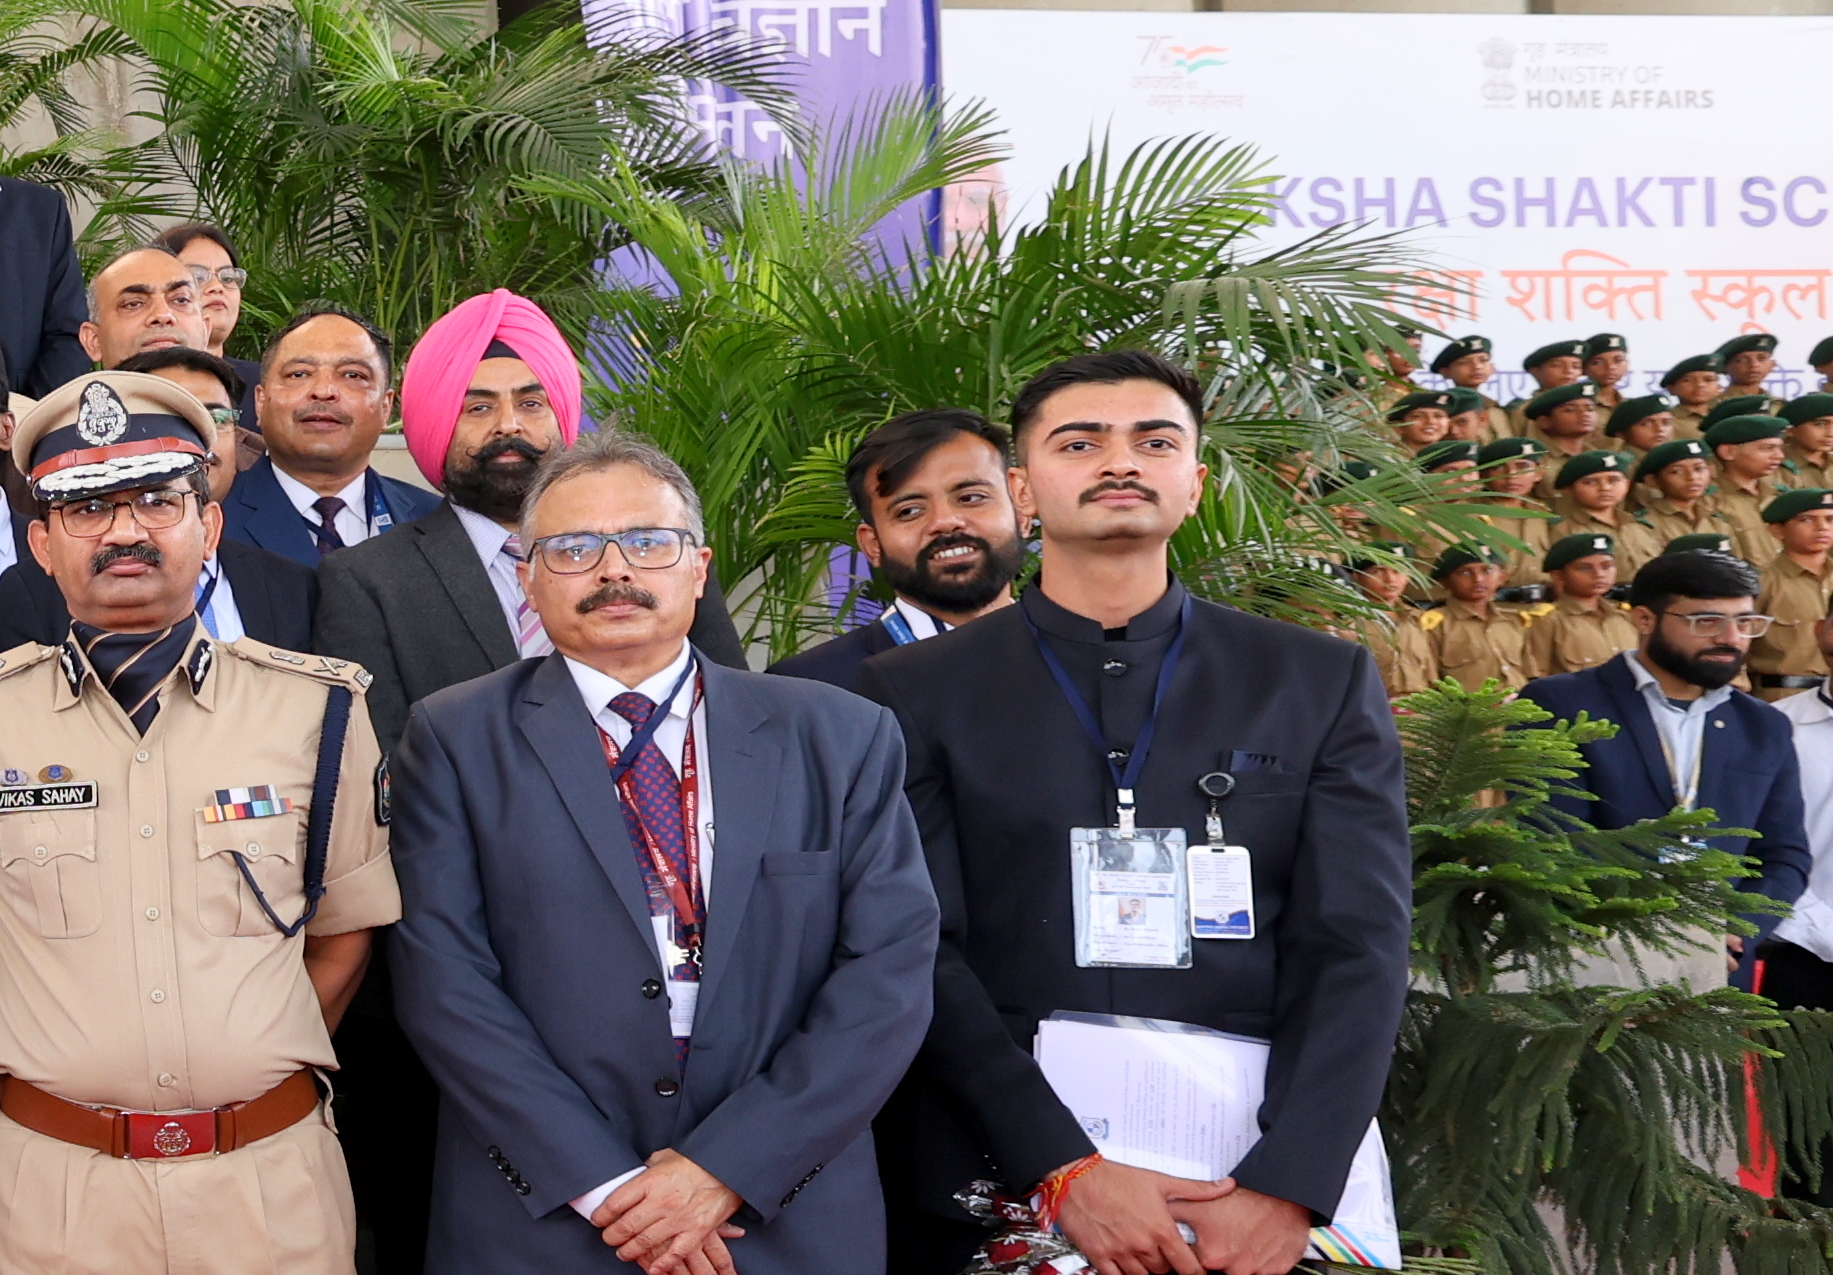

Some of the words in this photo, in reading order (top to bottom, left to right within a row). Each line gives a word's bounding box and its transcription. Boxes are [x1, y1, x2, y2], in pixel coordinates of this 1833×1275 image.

[1524, 66, 1629, 84] MINISTRY
[1634, 66, 1665, 84] OF
[1525, 89, 1604, 109] HOME
[1610, 89, 1715, 109] AFFAIRS
[1467, 176, 1717, 228] SHAKTI
[1500, 249, 1670, 322] शक्ति
[41, 787, 86, 804] SAHAY
[685, 790, 694, 810] Affairs
[687, 810, 695, 827] Home
[689, 835, 698, 857] Ministry
